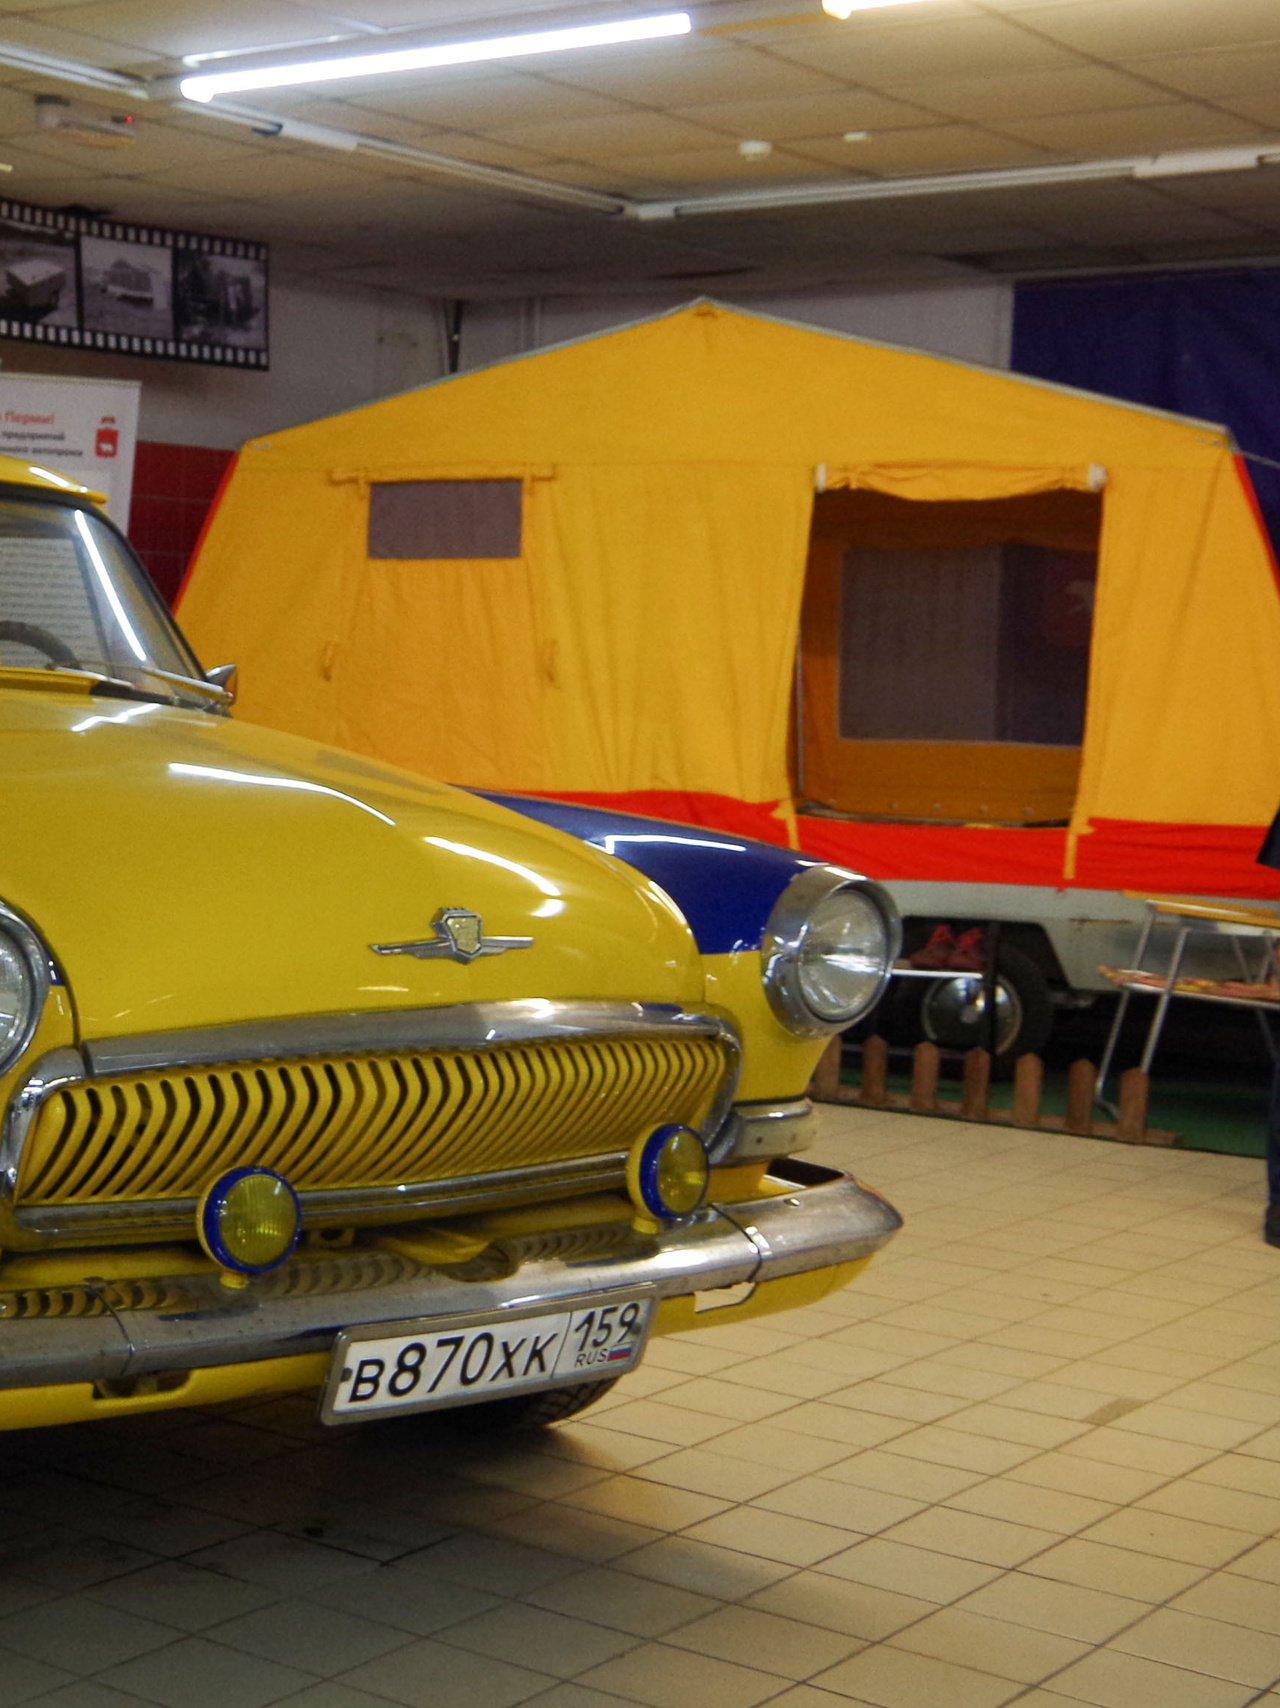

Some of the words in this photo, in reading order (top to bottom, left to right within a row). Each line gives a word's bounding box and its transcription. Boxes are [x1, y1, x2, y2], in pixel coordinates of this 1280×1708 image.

[348, 1331, 558, 1403] В870ХК
[574, 1302, 641, 1352] 159
[574, 1347, 608, 1368] RUS
